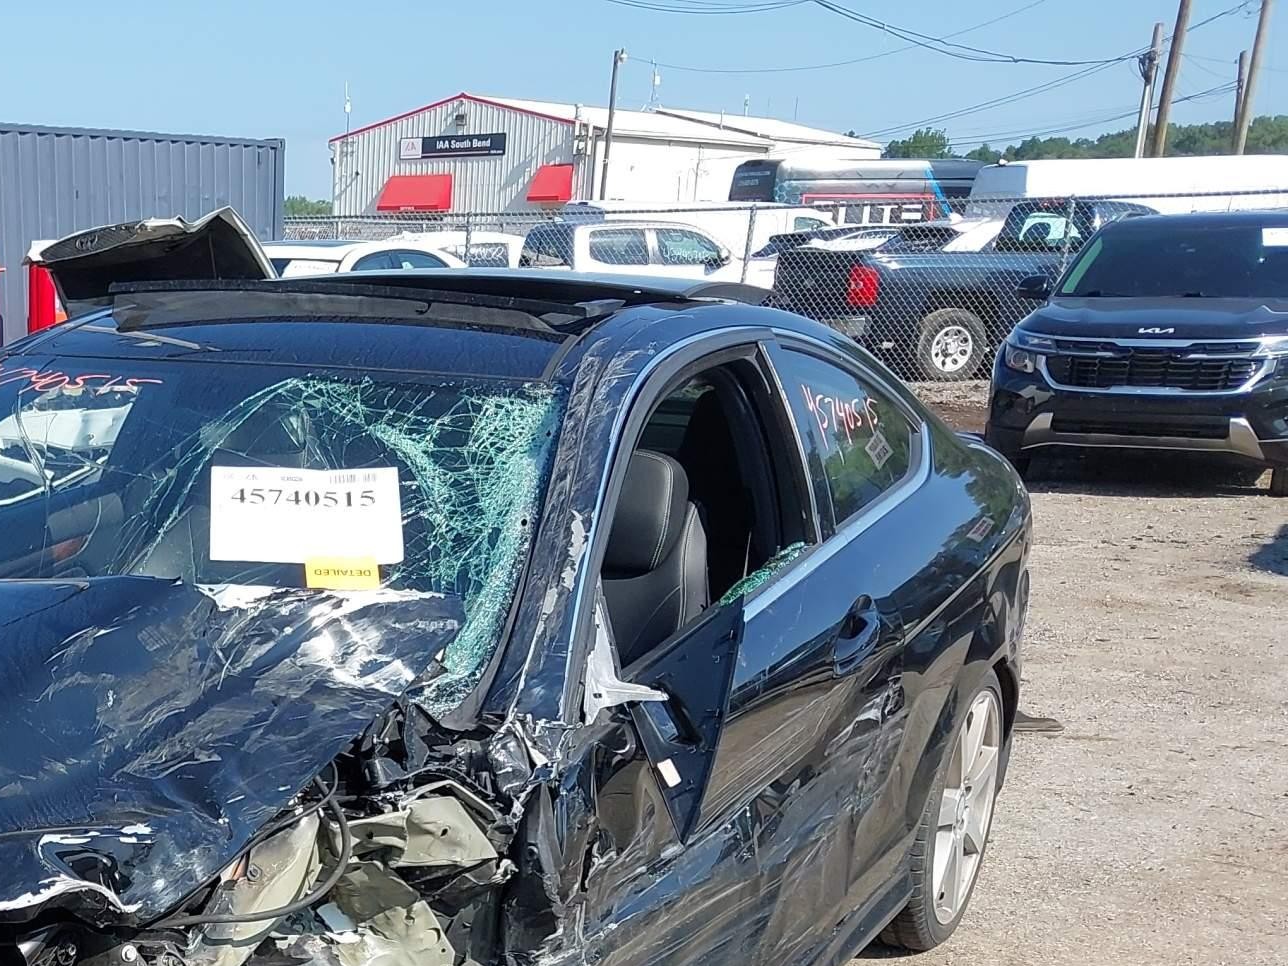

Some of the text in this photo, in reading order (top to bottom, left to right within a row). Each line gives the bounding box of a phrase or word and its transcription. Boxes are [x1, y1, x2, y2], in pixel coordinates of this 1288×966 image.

[436, 137, 491, 150] IAA South Bend
[813, 201, 923, 226] LITE
[801, 383, 878, 450] 45740515
[231, 488, 376, 507] 45740515
[314, 569, 372, 577] DETAILED
